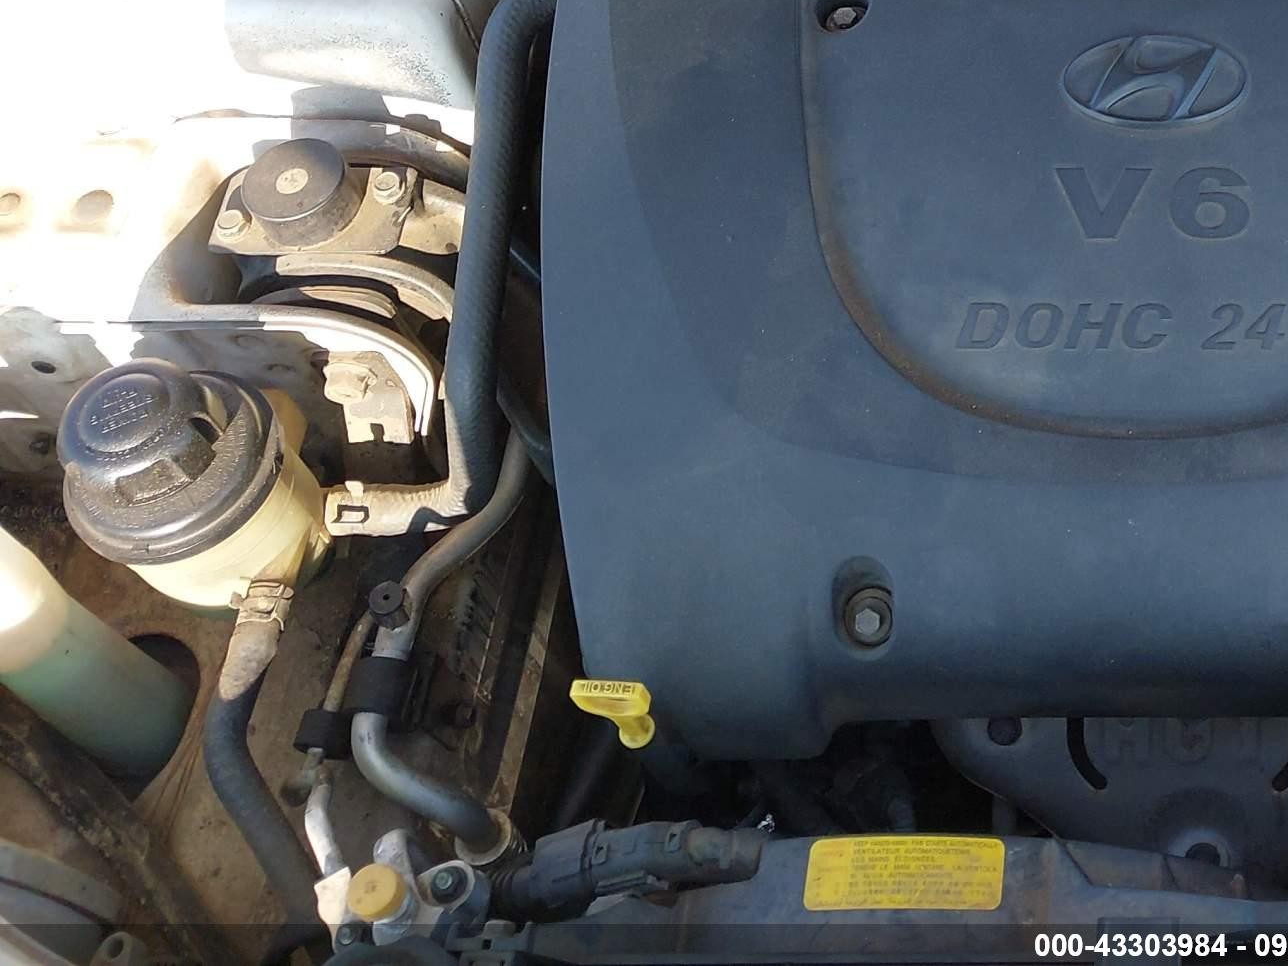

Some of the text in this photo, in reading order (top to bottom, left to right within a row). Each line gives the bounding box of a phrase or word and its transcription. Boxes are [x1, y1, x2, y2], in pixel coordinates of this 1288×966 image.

[1054, 165, 1252, 241] V6
[954, 301, 1174, 351] DOHC
[581, 682, 637, 695] ENG OIL
